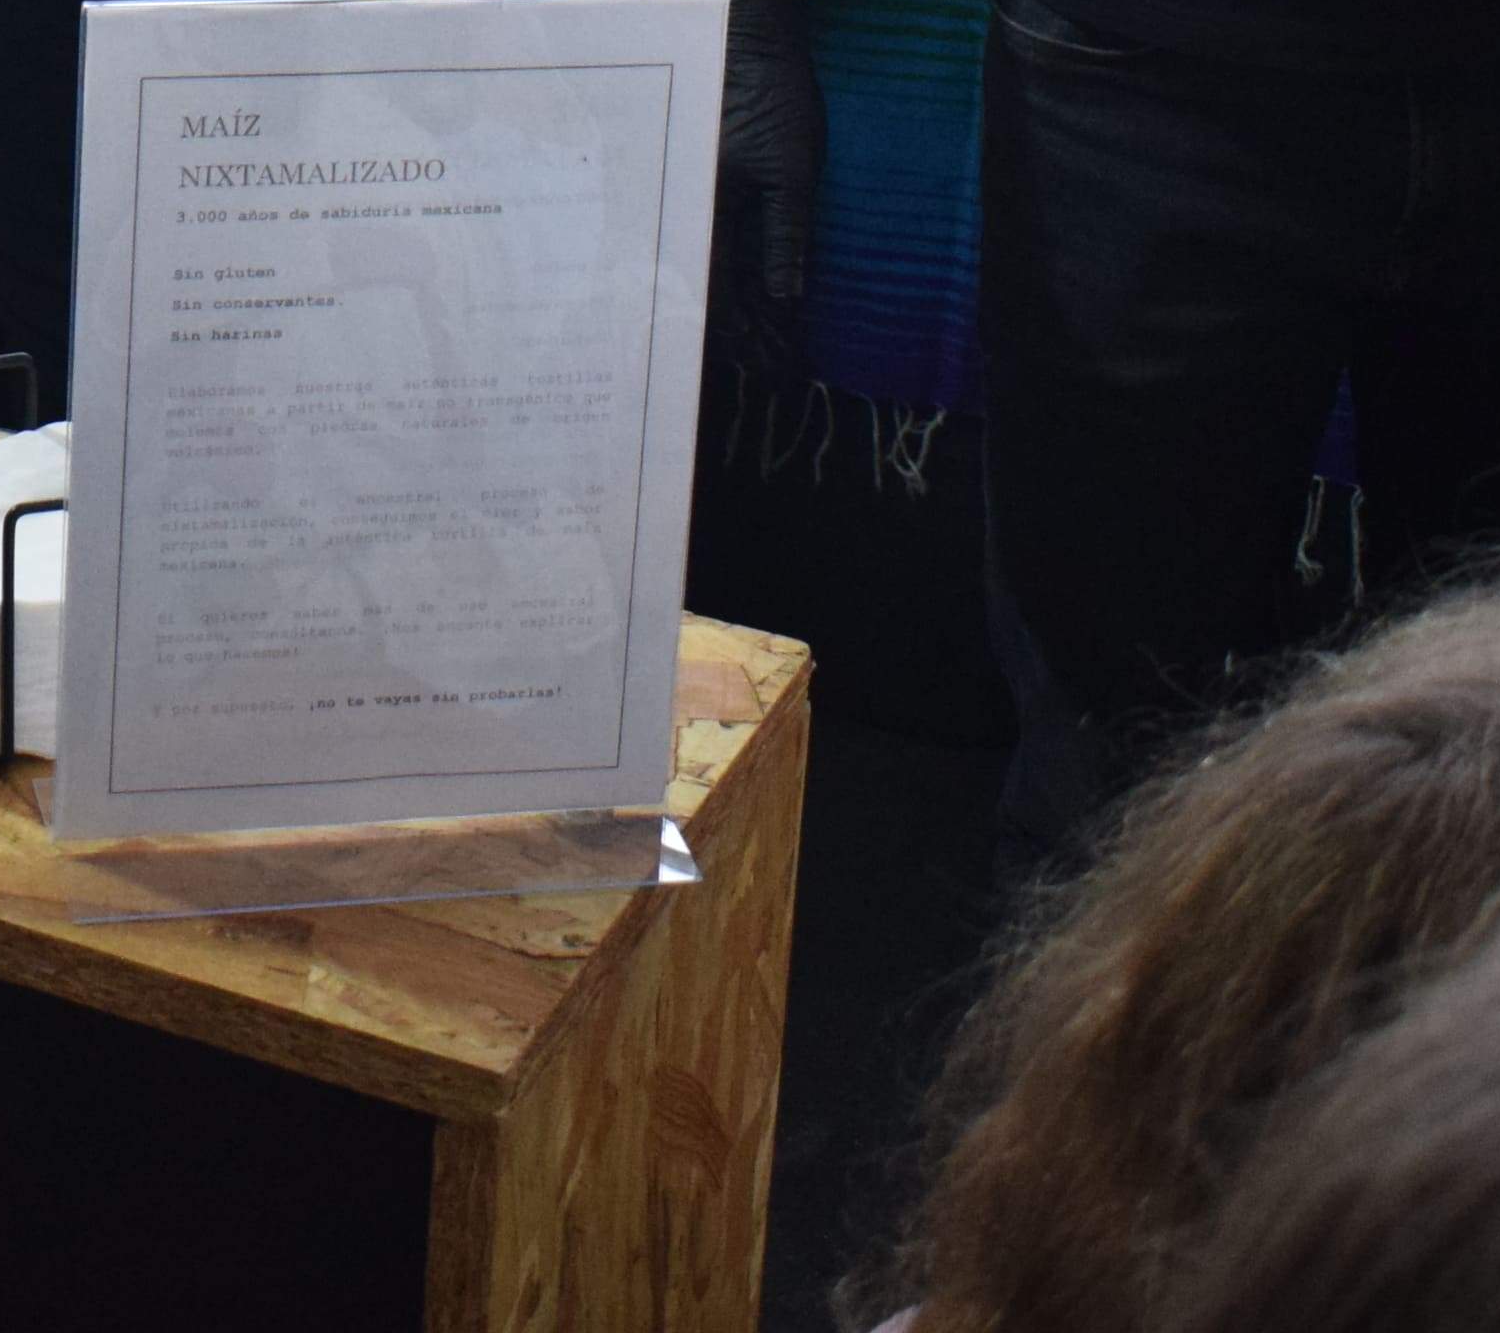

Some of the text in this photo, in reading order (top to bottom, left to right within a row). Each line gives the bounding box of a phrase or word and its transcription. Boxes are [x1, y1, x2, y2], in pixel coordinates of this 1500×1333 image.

[180, 108, 261, 139] MAÍZ
[178, 158, 446, 189] NIXTAMALIZADO
[176, 209, 227, 224] 3.000
[238, 206, 278, 222] años
[289, 207, 309, 220] de
[422, 202, 502, 216] mexicana
[173, 266, 276, 282] Sin gluten
[172, 295, 344, 311] Sin conservantes.
[170, 328, 283, 342] Sin harinas
[347, 696, 365, 708] te
[374, 693, 421, 707] vayas
[431, 691, 459, 703] sin
